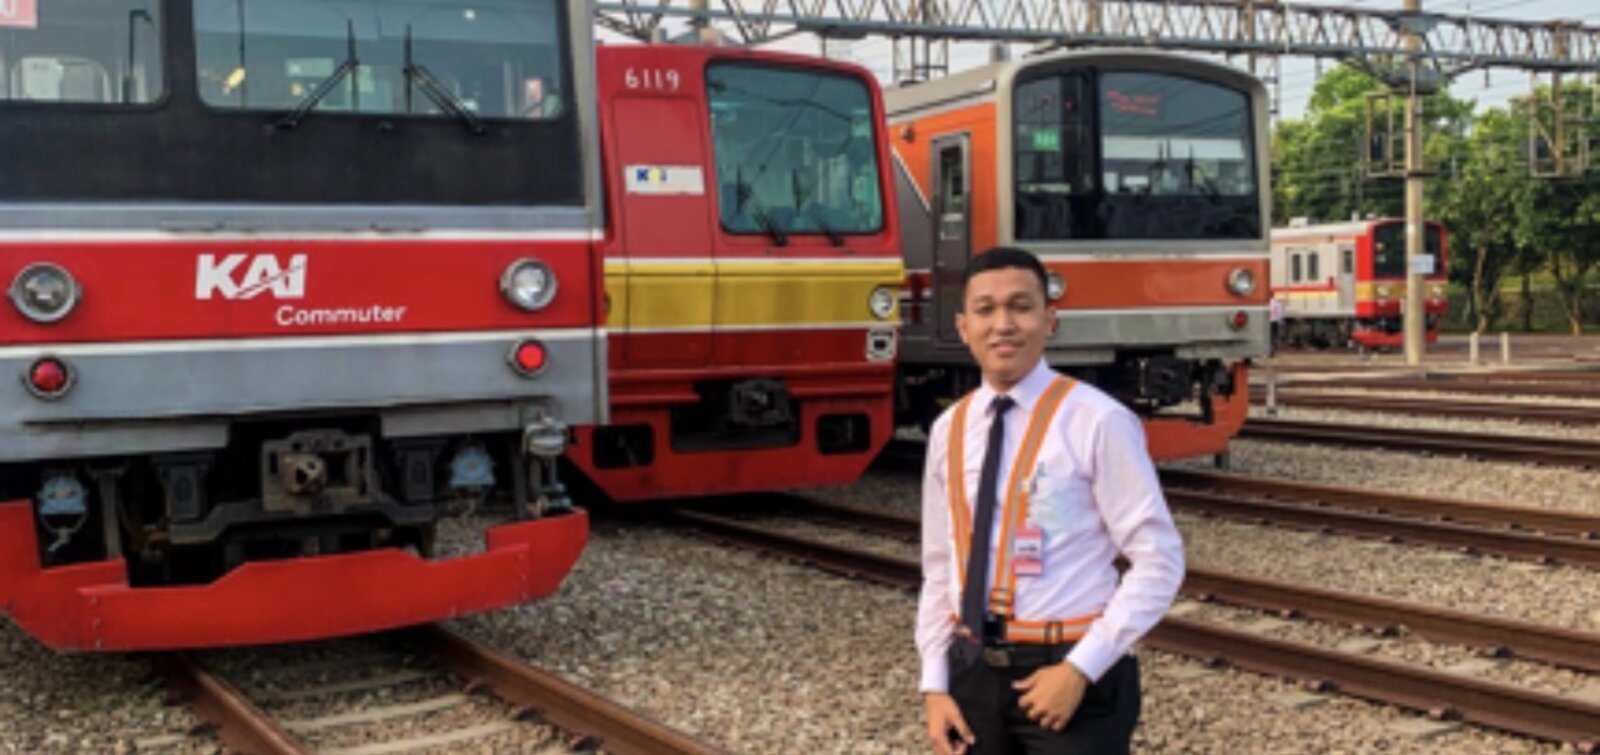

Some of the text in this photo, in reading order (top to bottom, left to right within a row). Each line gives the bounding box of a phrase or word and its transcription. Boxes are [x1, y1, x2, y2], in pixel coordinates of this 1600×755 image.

[625, 67, 680, 90] 6119
[195, 254, 308, 300] KAI
[276, 305, 407, 326] Commuter
